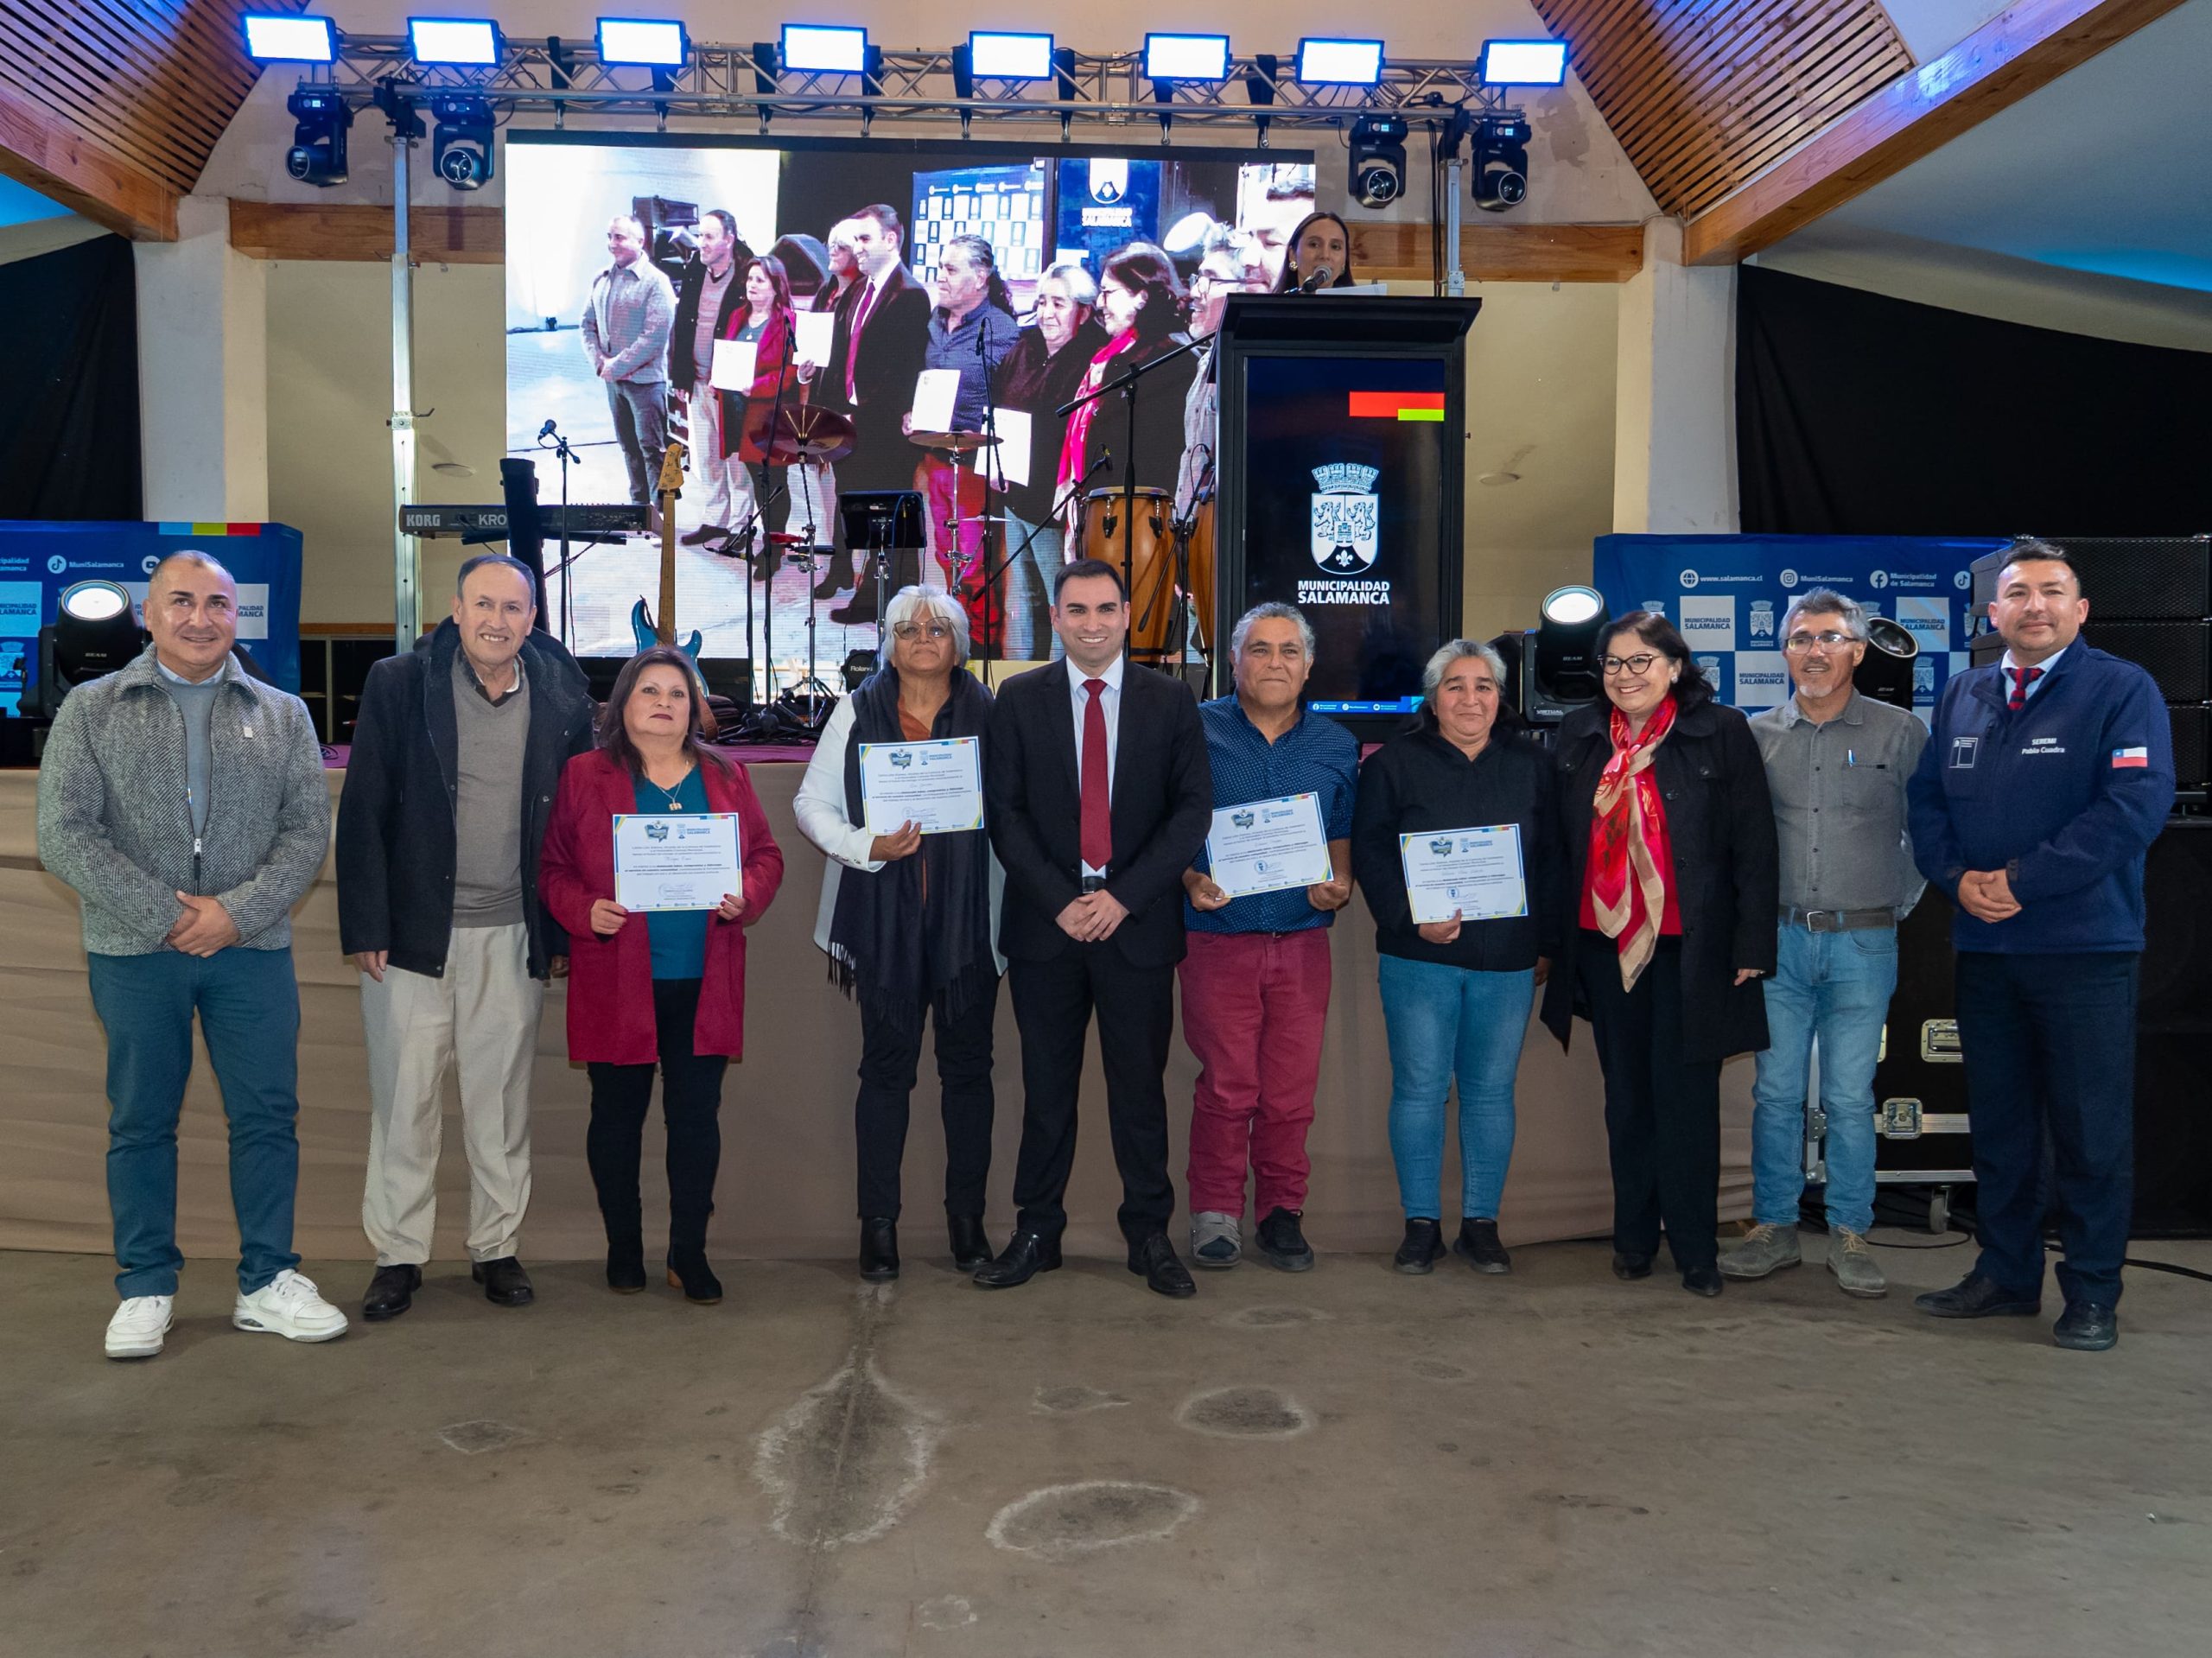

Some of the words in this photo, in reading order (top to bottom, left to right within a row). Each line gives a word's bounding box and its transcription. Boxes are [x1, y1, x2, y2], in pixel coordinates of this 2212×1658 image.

[406, 514, 441, 527] KORG
[479, 514, 507, 525] KRO
[1298, 581, 1390, 591] MUNICIPALIDAD
[1298, 591, 1390, 605] SALAMANCA
